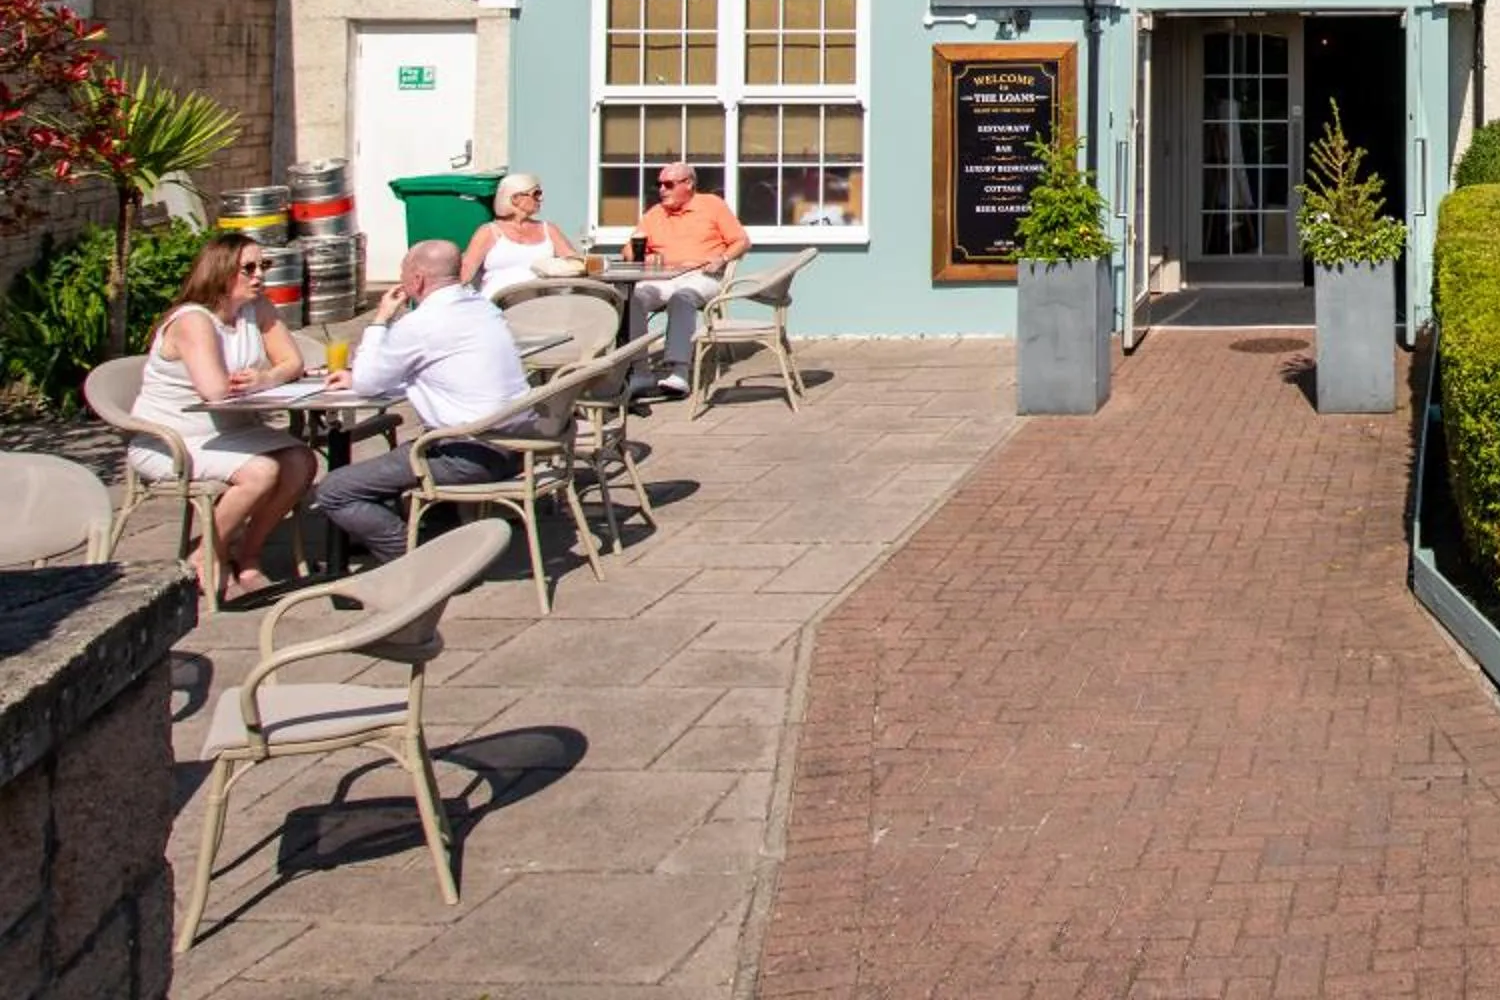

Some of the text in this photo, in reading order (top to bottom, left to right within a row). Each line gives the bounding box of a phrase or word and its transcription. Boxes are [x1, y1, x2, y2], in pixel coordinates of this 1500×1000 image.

[973, 73, 1035, 86] WELCOME
[973, 93, 1035, 103] THE LOANS
[977, 125, 1030, 133] RESTAURANT
[995, 145, 1012, 153] BAR
[965, 165, 996, 173] LUXURY
[984, 185, 1024, 193] COTTAGE
[975, 205, 997, 213] BEER
